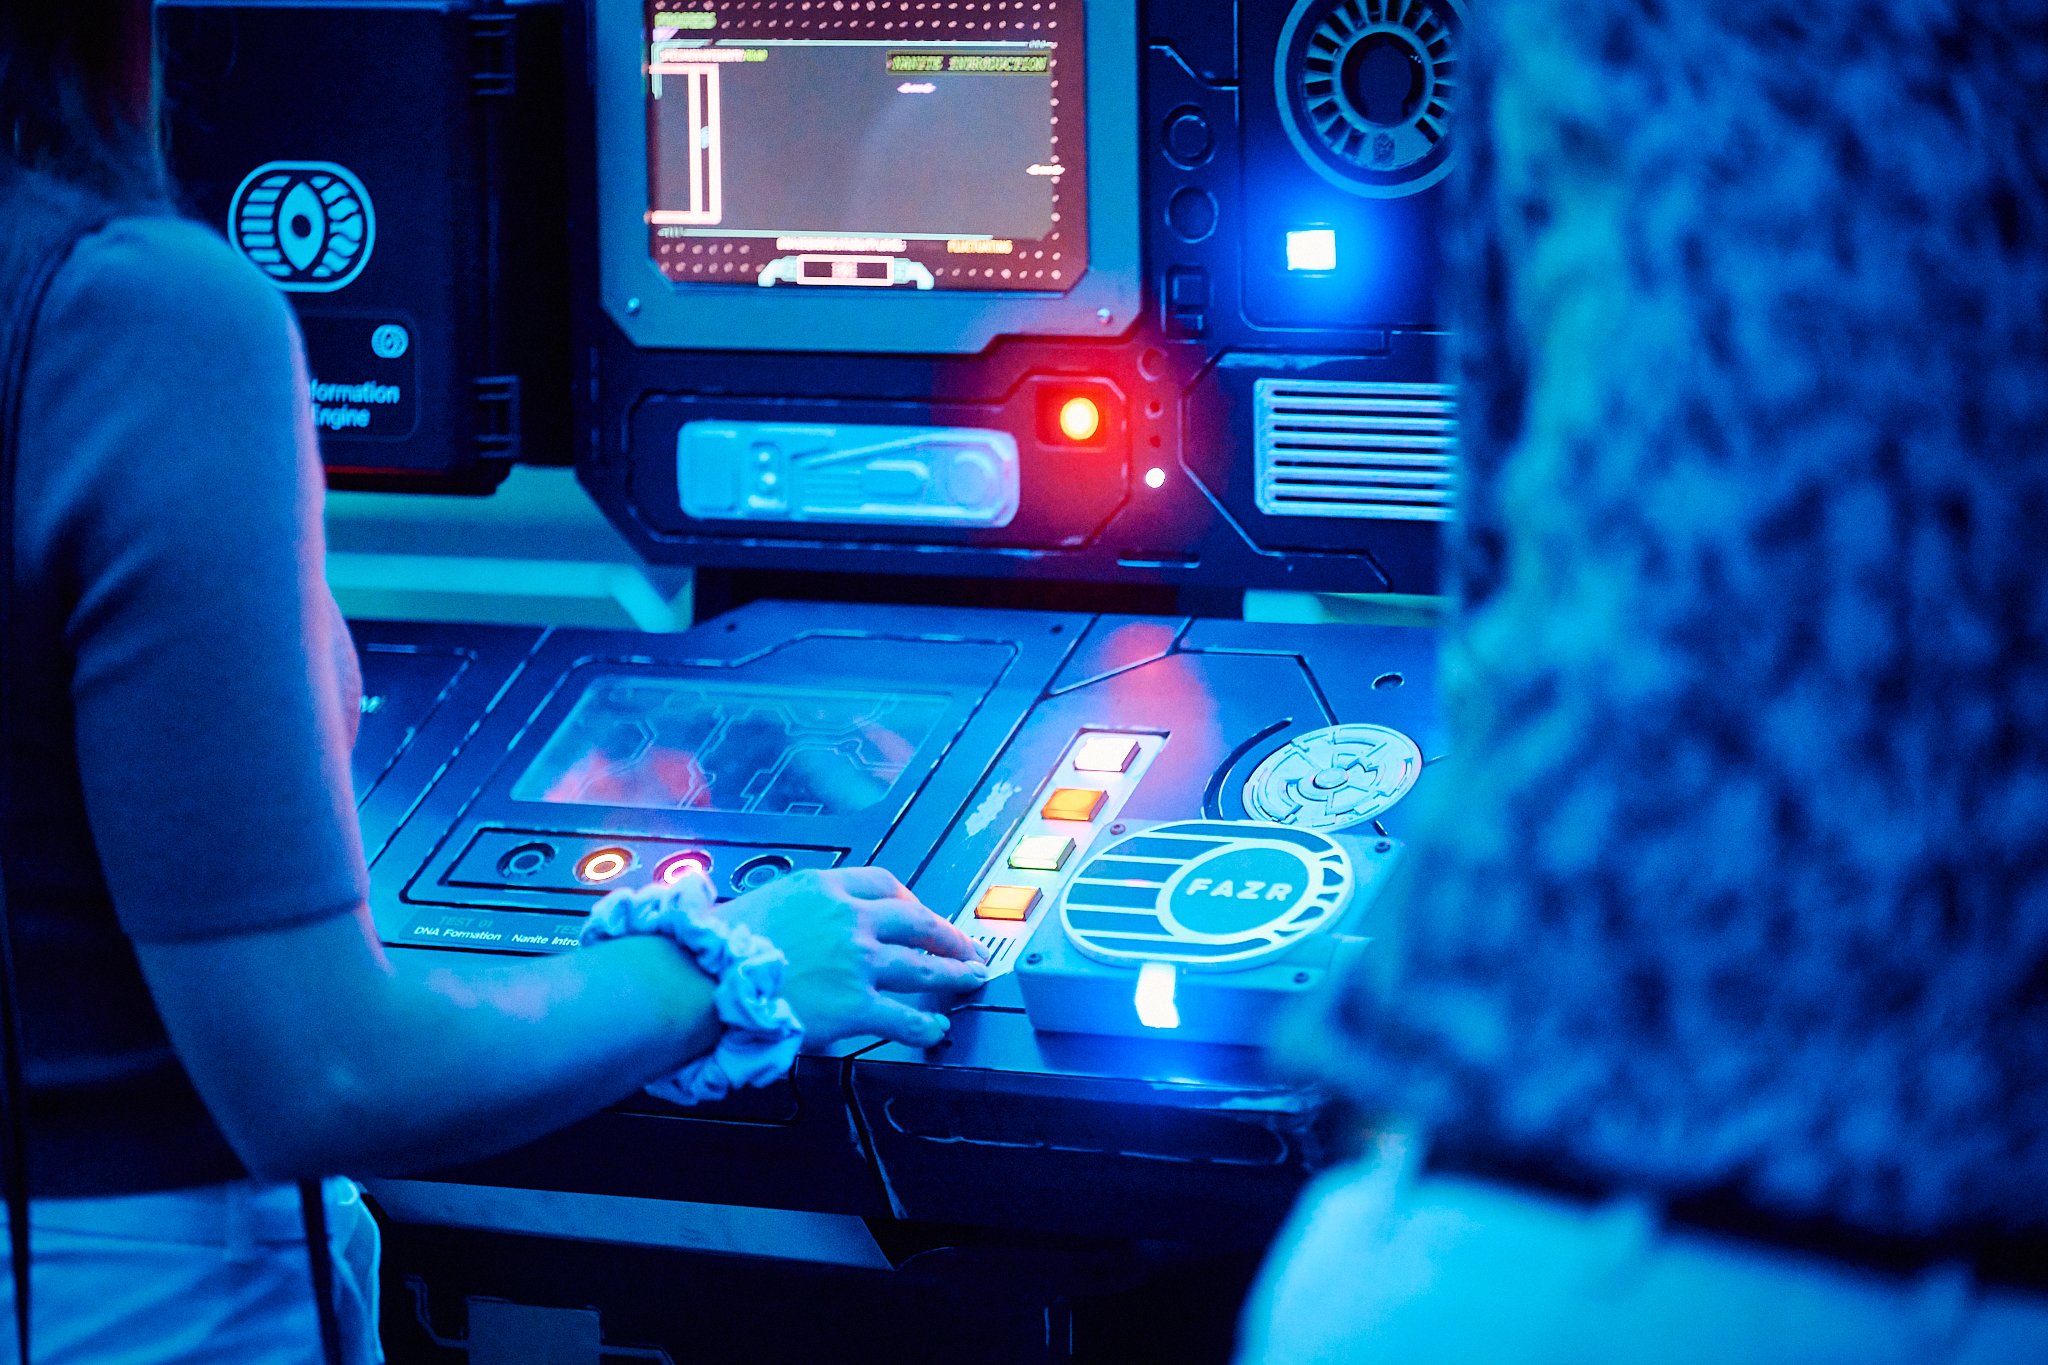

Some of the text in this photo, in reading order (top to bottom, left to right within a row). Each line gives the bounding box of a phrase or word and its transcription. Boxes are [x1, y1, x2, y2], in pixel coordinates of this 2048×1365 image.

[891, 55, 1048, 72] NANITE INTRODUCTION
[1185, 877, 1294, 902] FAZR
[440, 916, 475, 927] TEST
[553, 924, 582, 935] TES
[413, 926, 582, 947] DNA Formation Nanite Intro
